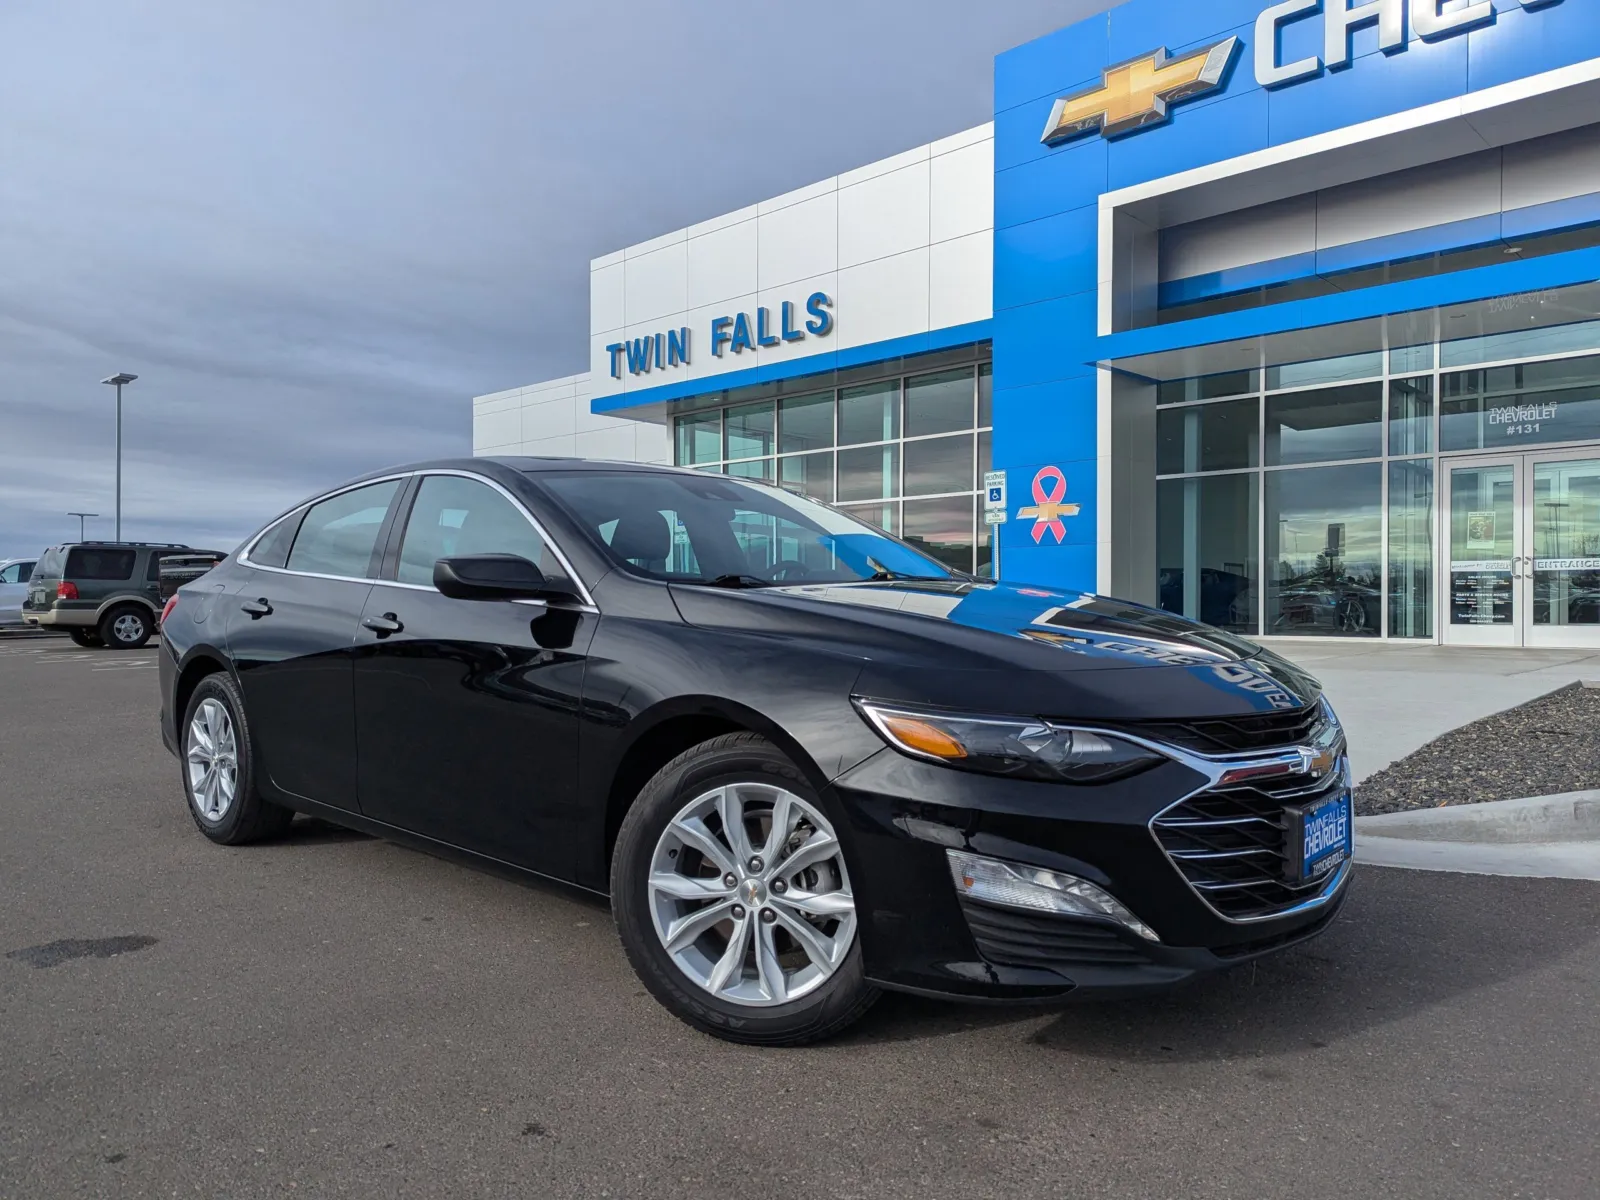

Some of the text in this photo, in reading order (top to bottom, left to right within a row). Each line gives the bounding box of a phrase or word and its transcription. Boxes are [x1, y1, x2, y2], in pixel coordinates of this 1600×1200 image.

[606, 291, 833, 380] TWIN FALLS
[1489, 408, 1557, 425] CHEVROLET
[1506, 423, 1540, 436] #131
[1537, 560, 1600, 569] ENTRANCE
[1305, 805, 1346, 837] TWINFALLS
[1304, 817, 1346, 859] CHEVROLET
